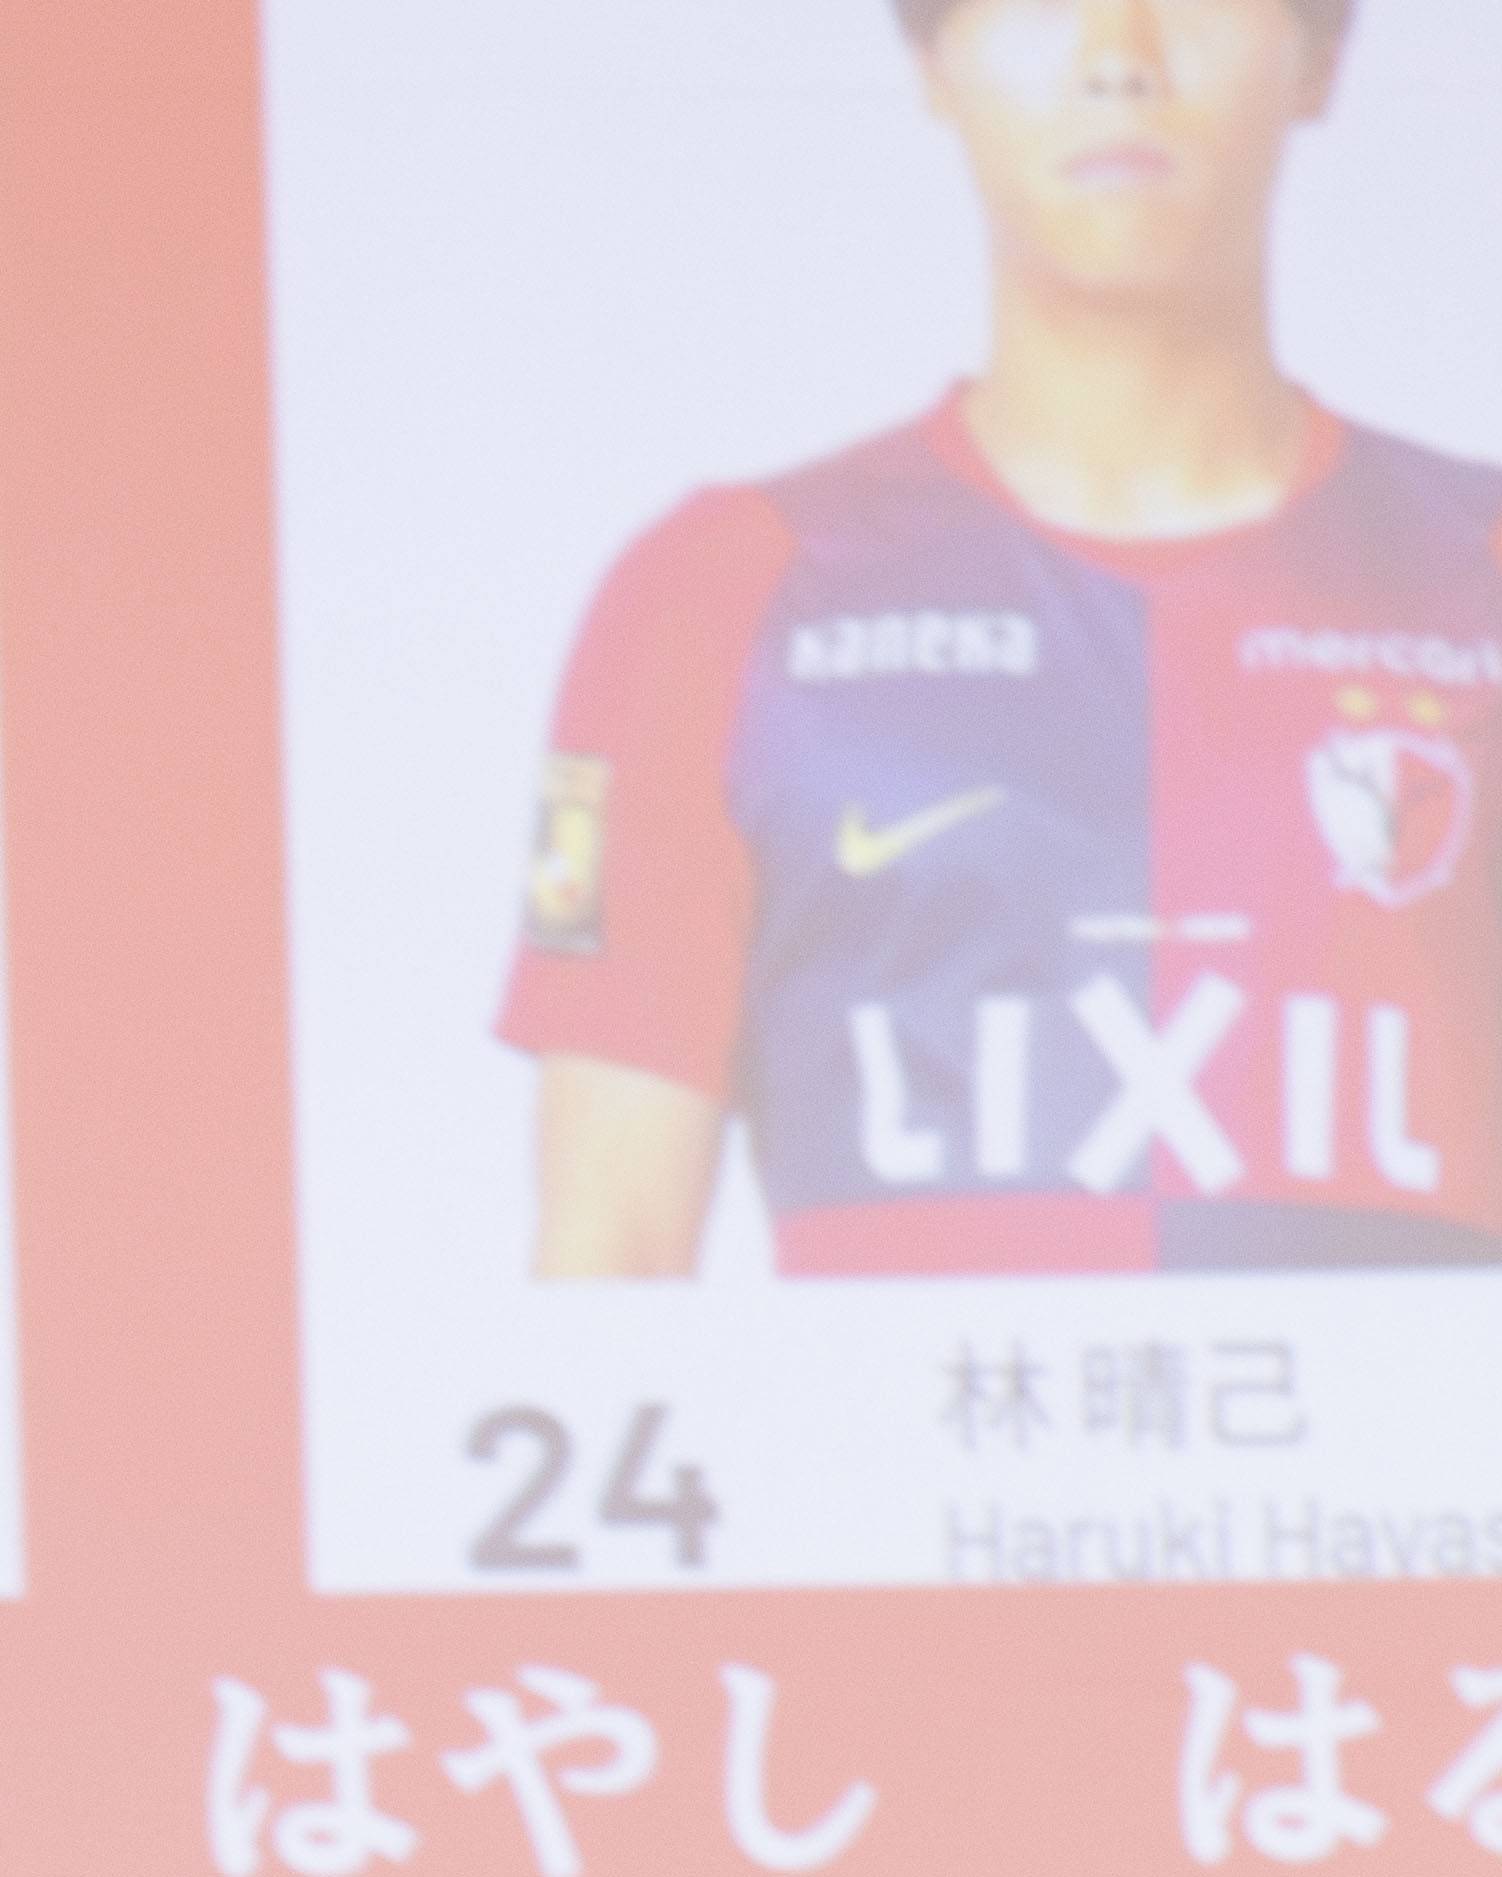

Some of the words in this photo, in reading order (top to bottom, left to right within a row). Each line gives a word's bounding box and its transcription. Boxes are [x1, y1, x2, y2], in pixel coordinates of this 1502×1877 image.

[846, 970, 1442, 1196] LIXIL
[462, 1400, 722, 1574] 24
[940, 1495, 1236, 1582] Haruki
